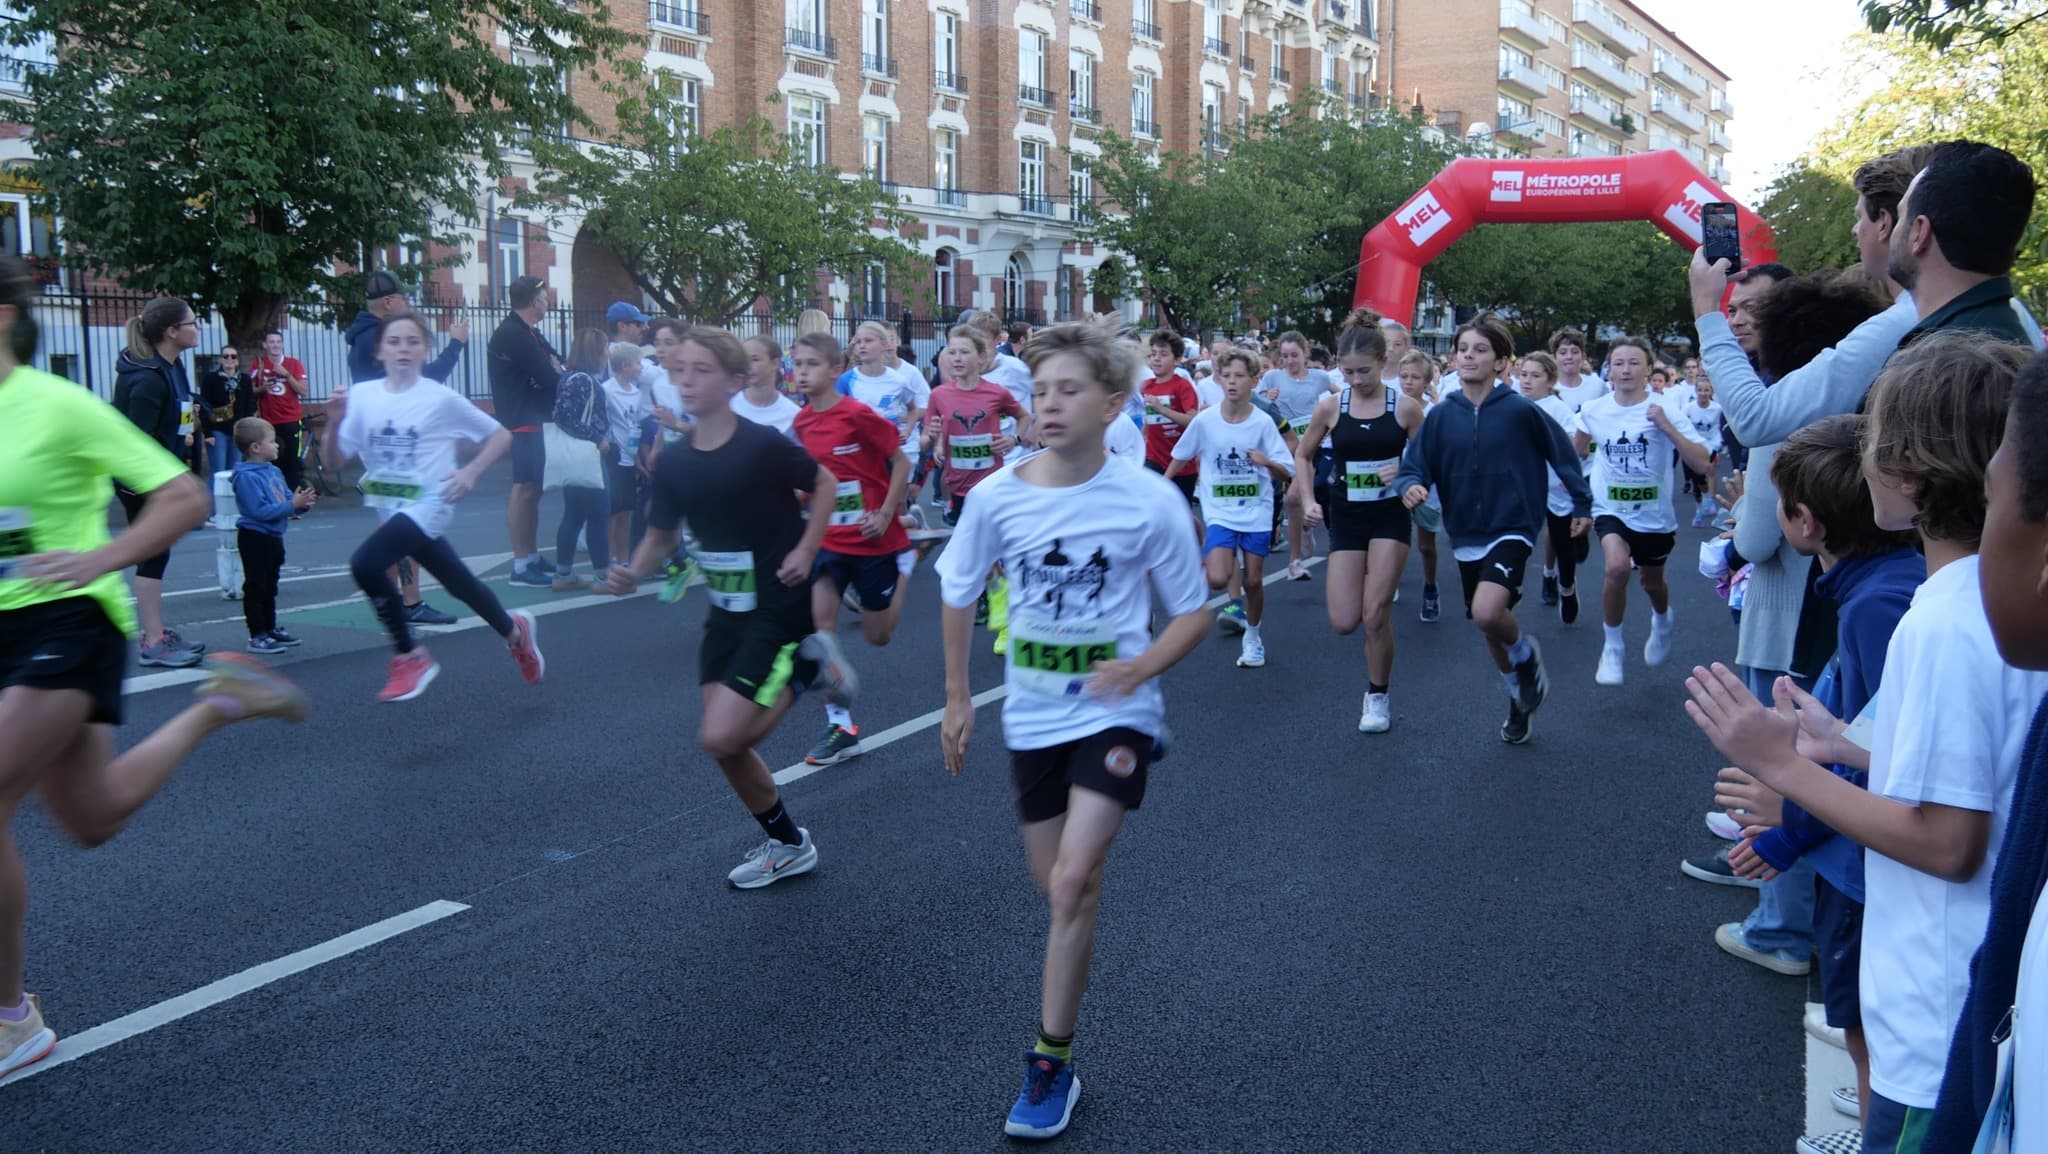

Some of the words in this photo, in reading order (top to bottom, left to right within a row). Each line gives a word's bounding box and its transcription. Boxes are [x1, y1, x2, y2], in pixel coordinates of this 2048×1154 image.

[1492, 180, 1523, 191] MEL
[1526, 173, 1622, 188] MÉTROPOLE
[1525, 188, 1581, 197] EUROPÉENNE
[1583, 188, 1596, 196] DE
[1597, 187, 1621, 195] LILLE
[953, 445, 990, 458] 1593
[1217, 485, 1256, 497] 1460
[1610, 488, 1654, 500] 1626
